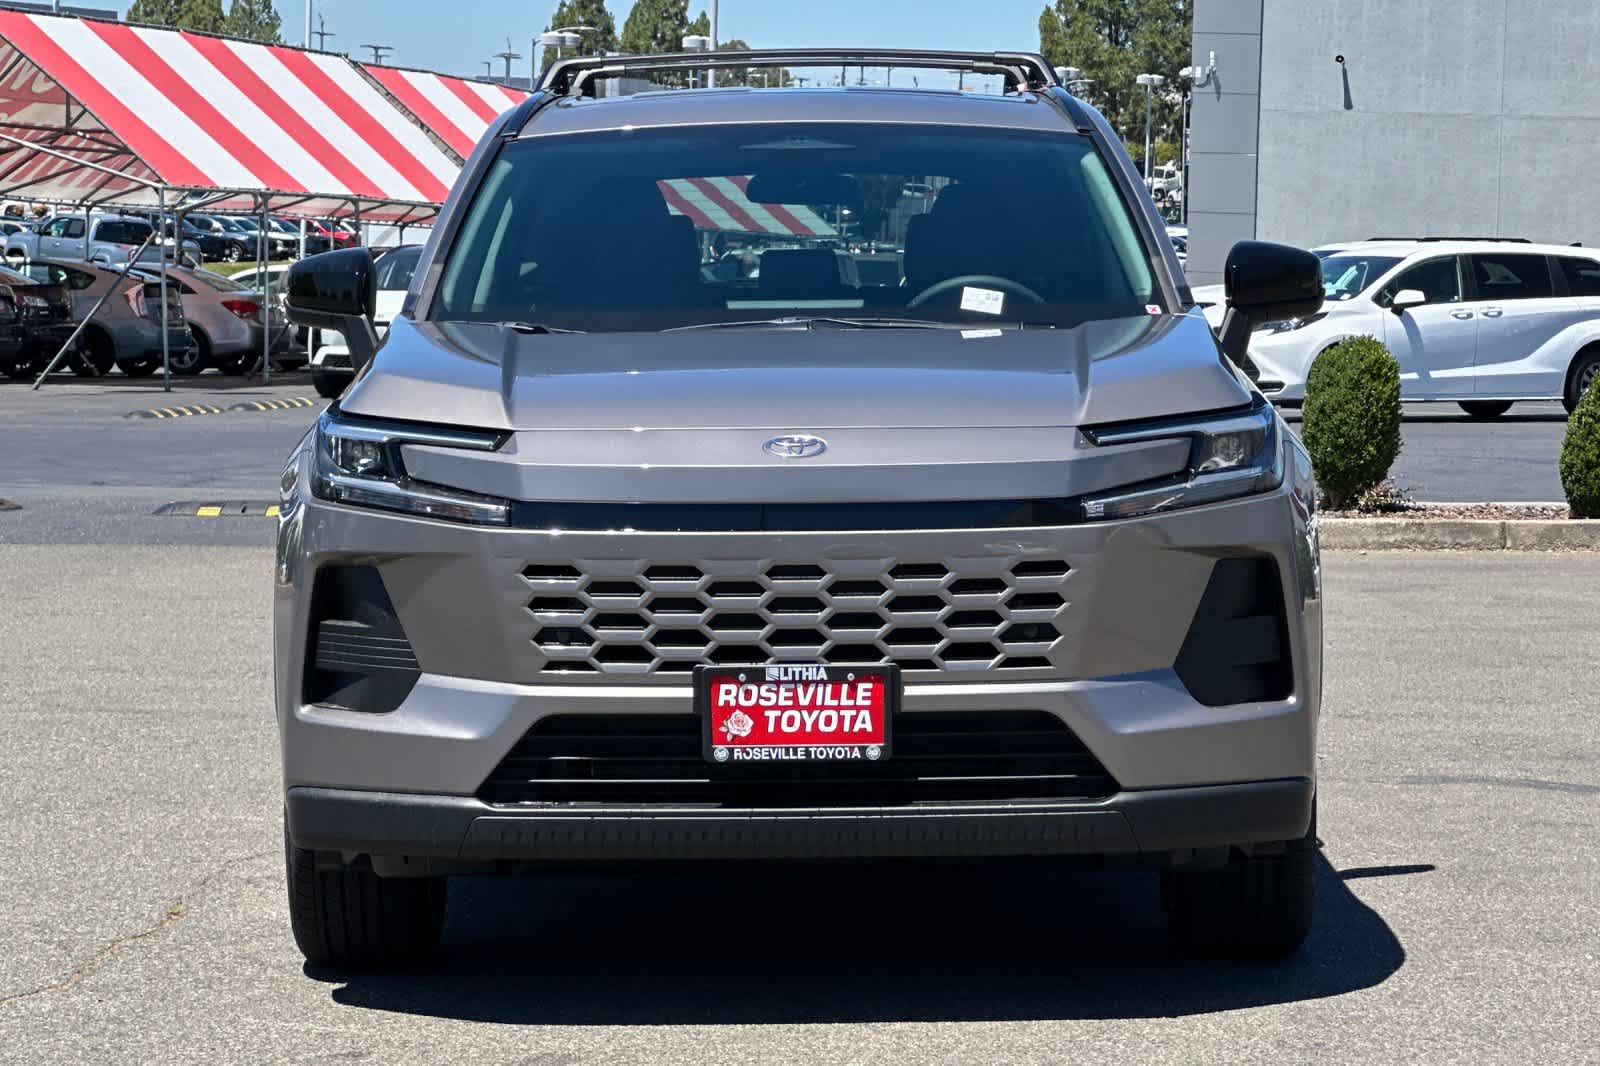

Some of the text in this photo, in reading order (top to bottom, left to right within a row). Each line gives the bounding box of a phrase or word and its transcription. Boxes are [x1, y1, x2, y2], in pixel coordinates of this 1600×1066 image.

[778, 666, 828, 681] LITHIA
[717, 683, 874, 707] ROSEVILLE
[764, 709, 873, 733] TOYOTA
[733, 746, 861, 760] ROSEVILLE TOYOTA
